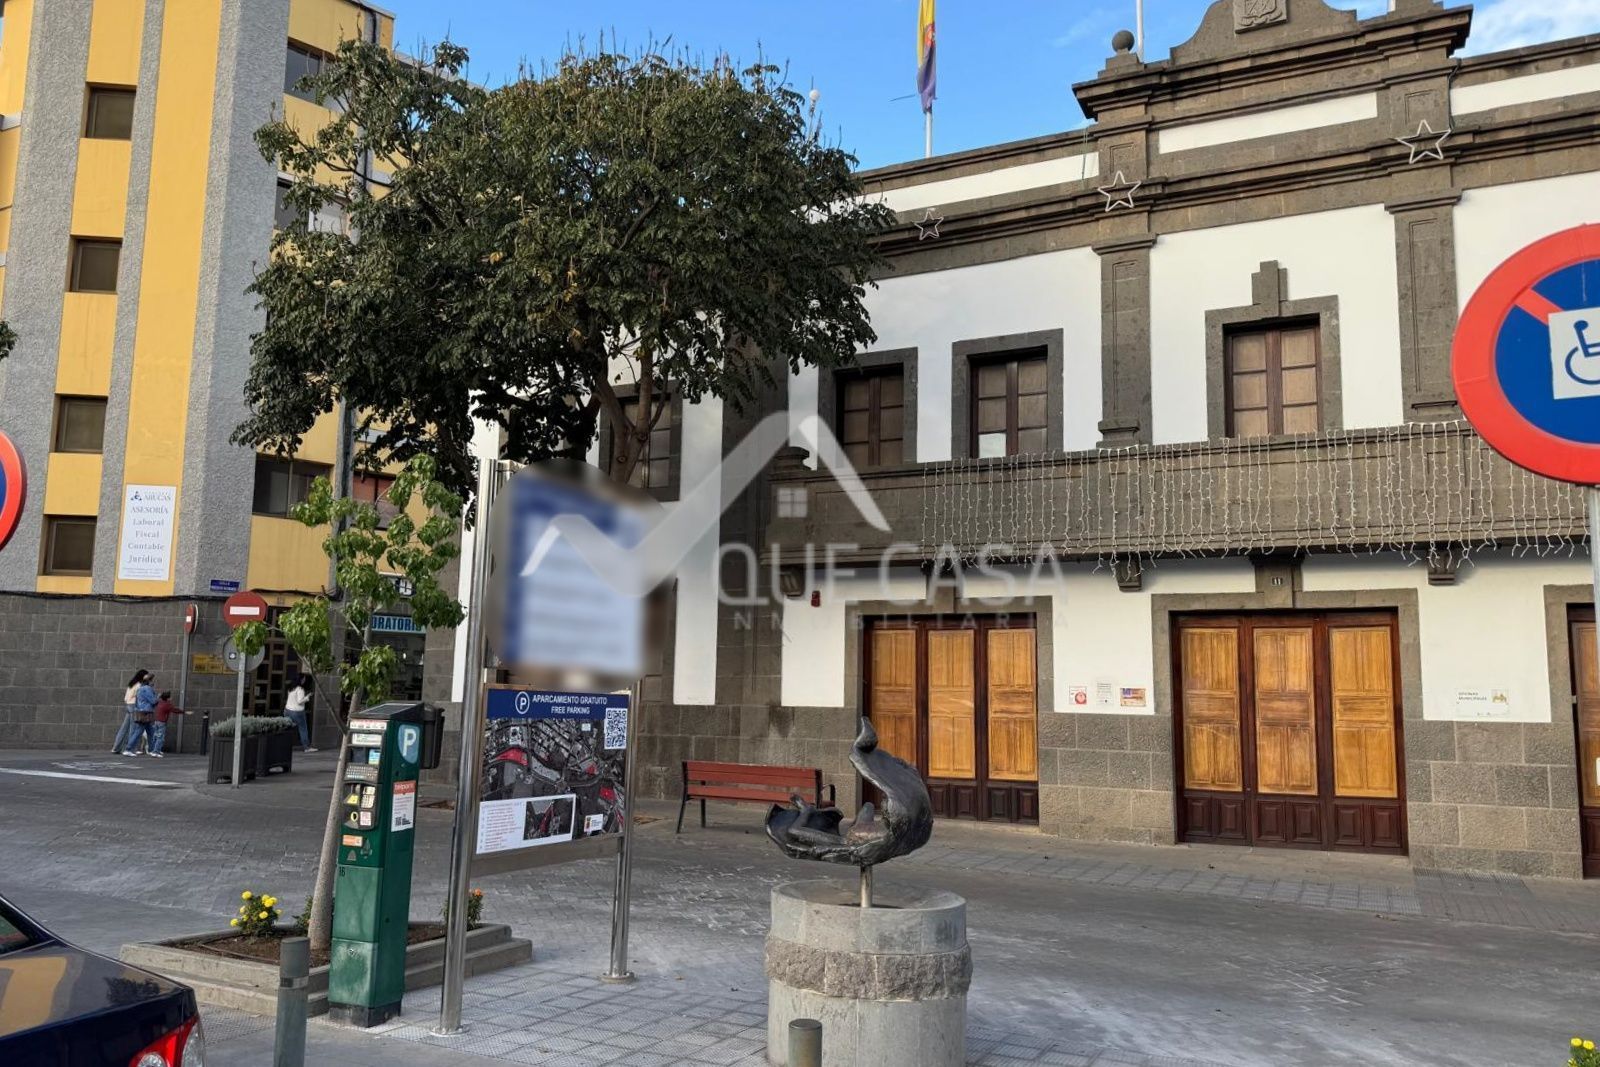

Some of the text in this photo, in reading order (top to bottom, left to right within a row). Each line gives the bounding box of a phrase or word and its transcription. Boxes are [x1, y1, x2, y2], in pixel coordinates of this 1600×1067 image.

[132, 518, 165, 526] Laboral
[135, 530, 160, 538] Fiscal
[127, 542, 165, 550] Contable
[532, 694, 608, 705] APARCAMIENTO GRATUITO
[551, 706, 591, 715] FREE PARKING
[402, 728, 417, 757] P
